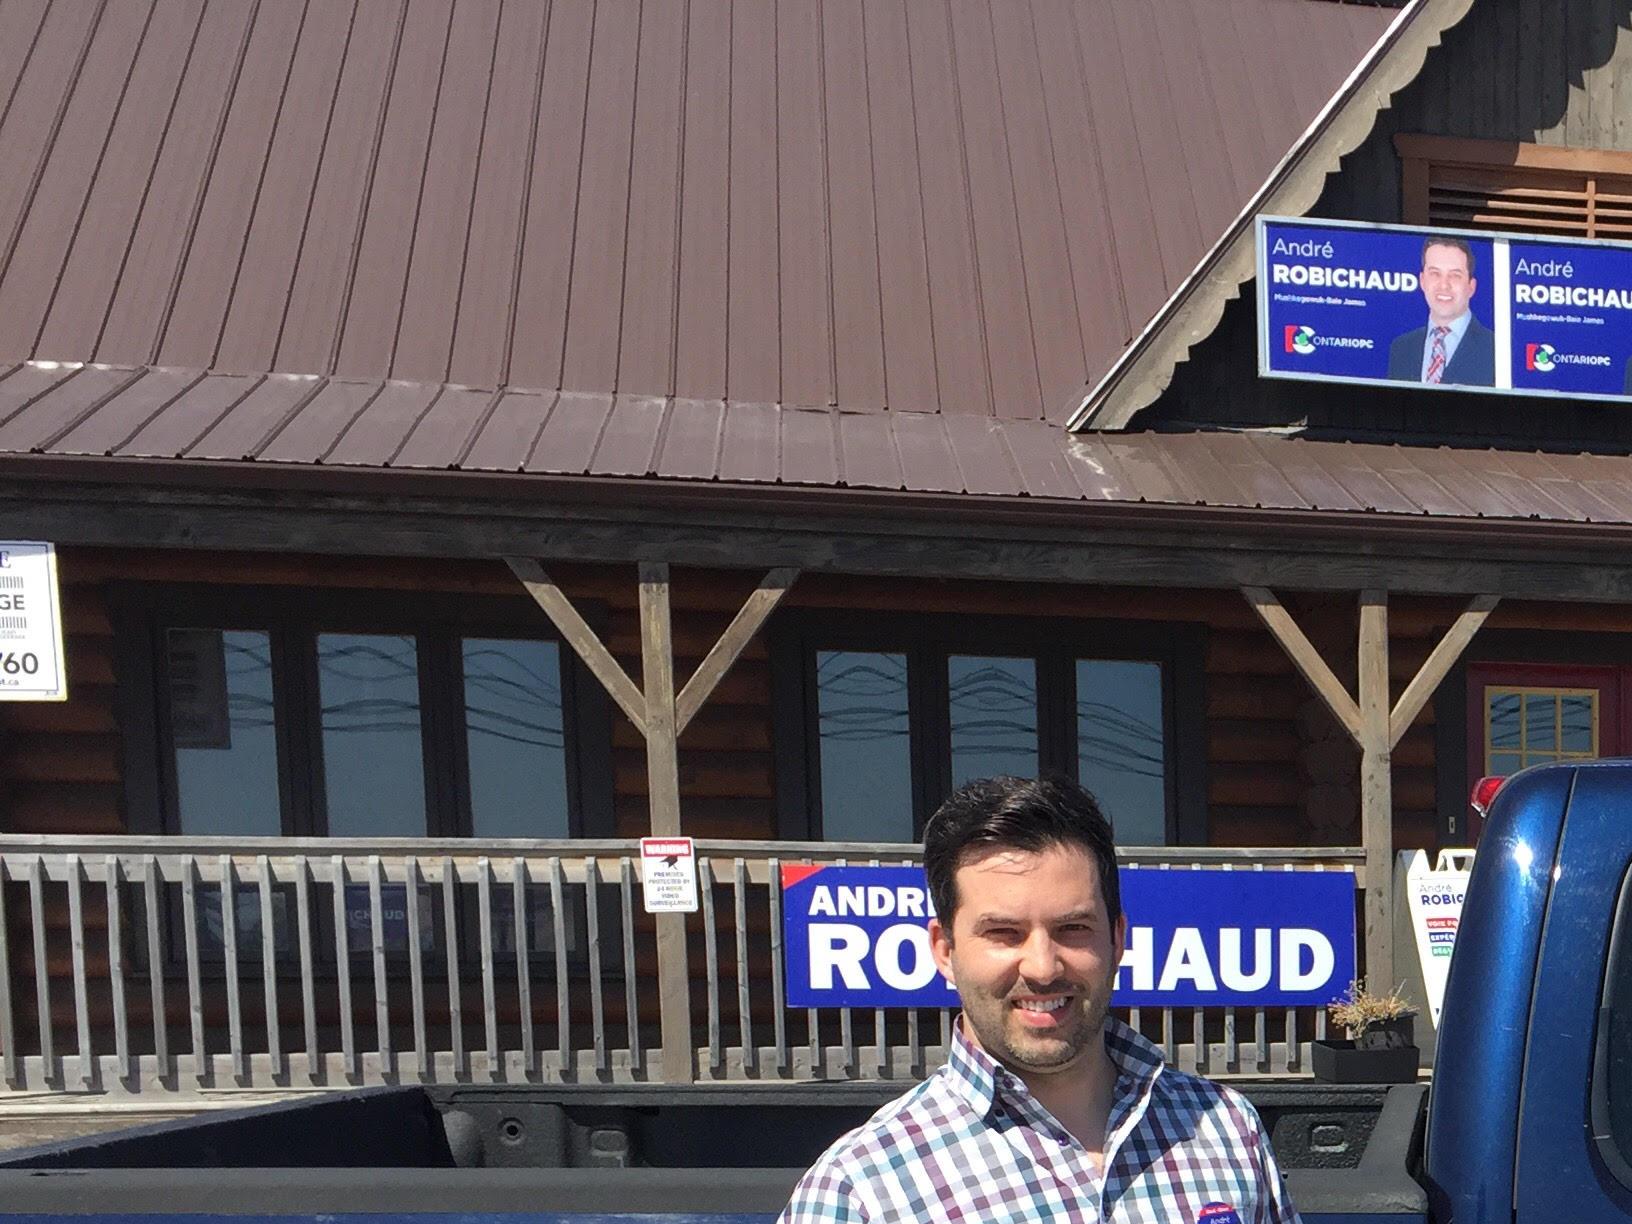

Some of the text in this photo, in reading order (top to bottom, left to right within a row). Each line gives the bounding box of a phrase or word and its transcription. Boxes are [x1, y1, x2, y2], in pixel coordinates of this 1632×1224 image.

[1272, 237, 1334, 259] André
[1273, 264, 1418, 292] ROBICHAUD
[1515, 258, 1574, 278] André
[645, 844, 690, 854] WARNING
